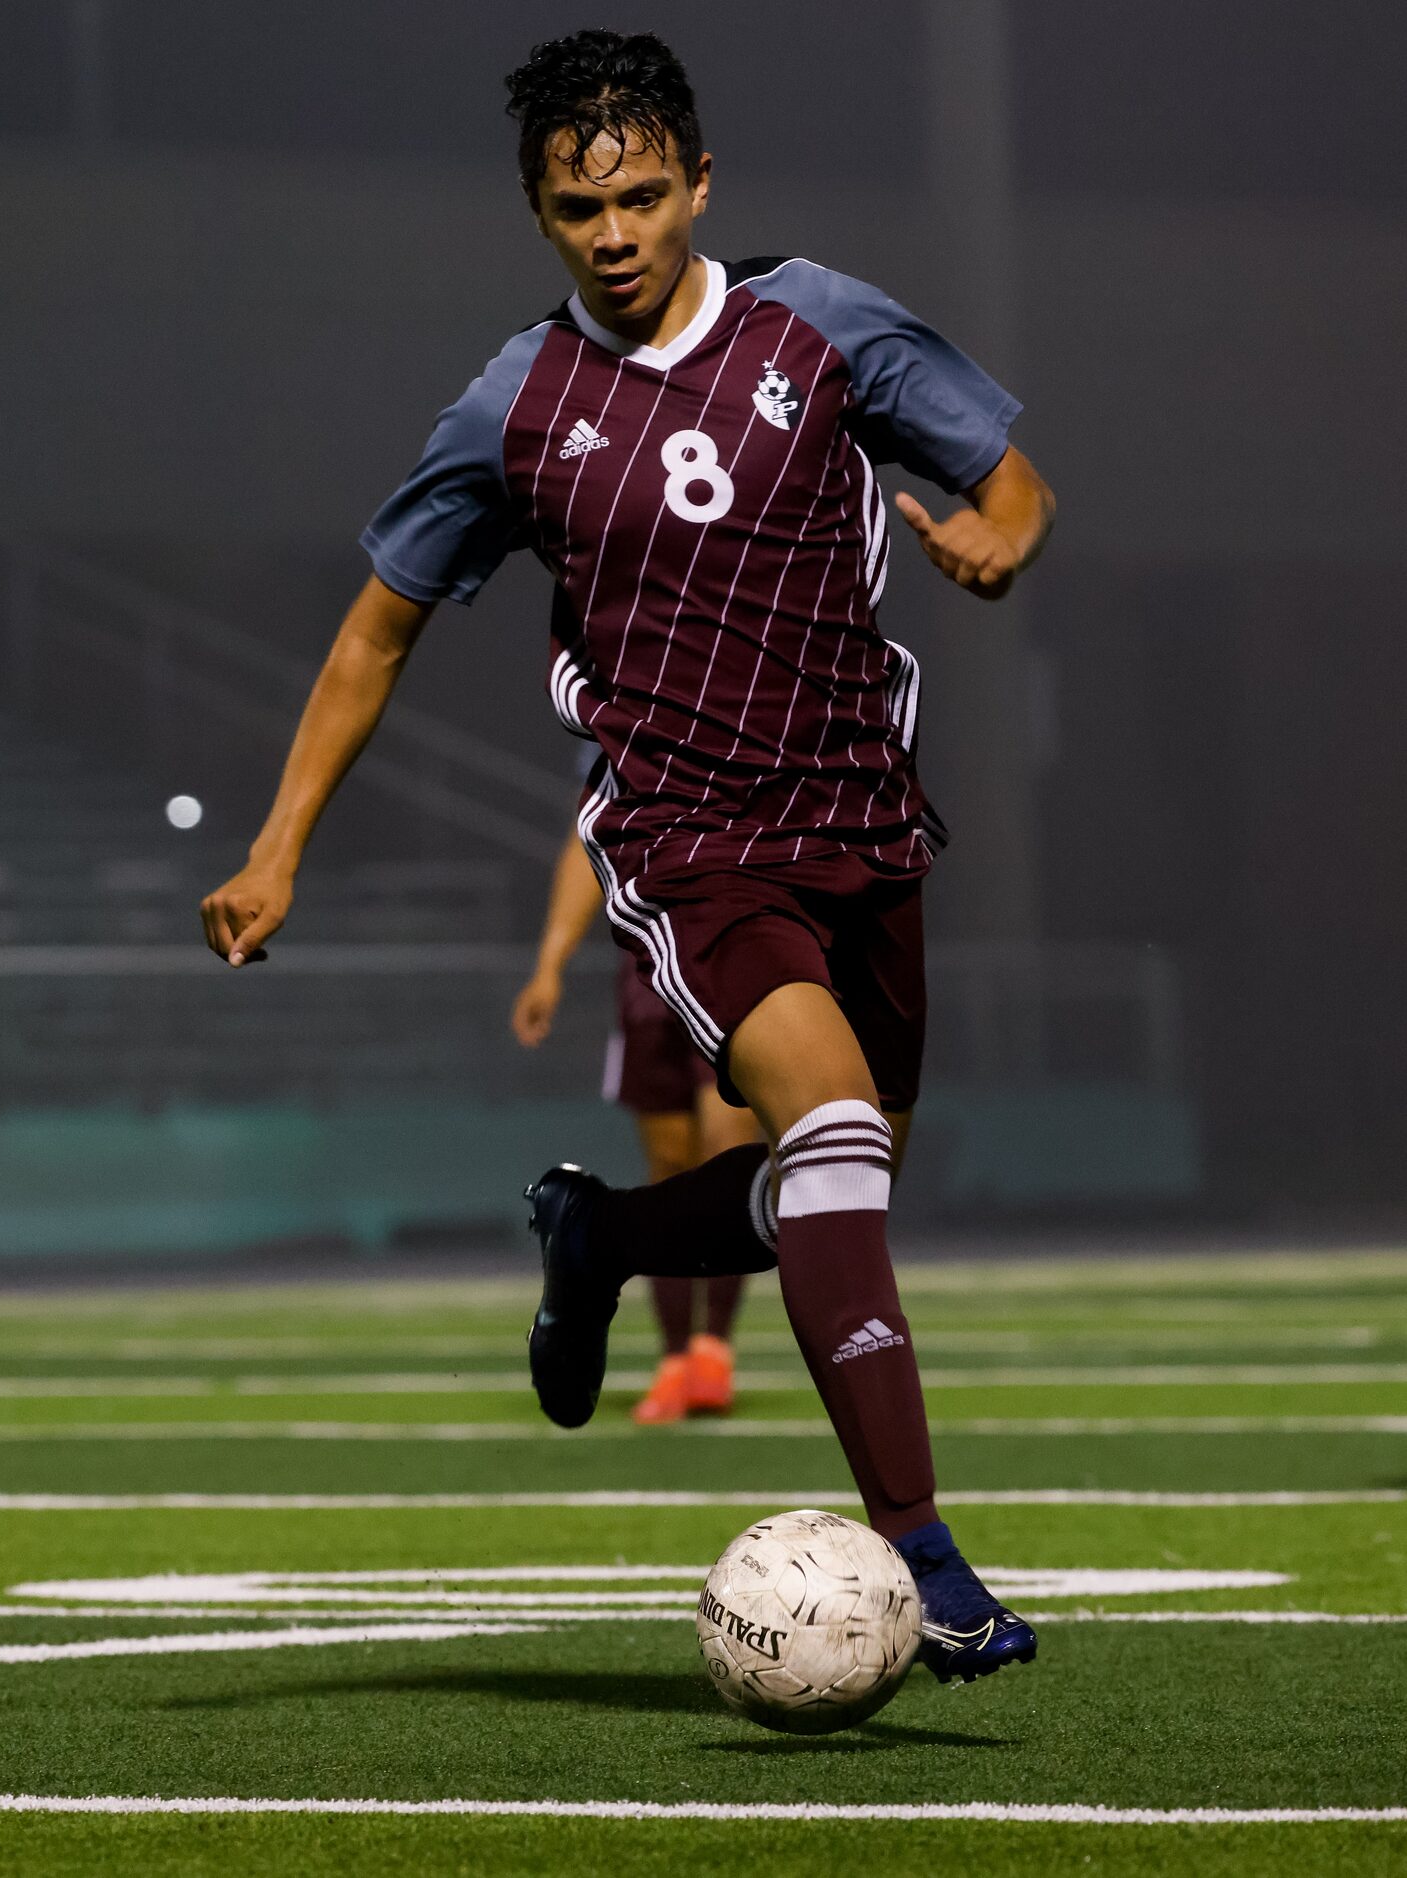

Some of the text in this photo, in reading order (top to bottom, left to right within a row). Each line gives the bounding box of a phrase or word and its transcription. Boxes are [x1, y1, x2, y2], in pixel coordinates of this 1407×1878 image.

[773, 401, 799, 420] P
[559, 437, 610, 459] adidas
[661, 429, 735, 523] 8
[832, 1334, 905, 1363] adidas
[697, 1583, 787, 1661] SPALDIN
